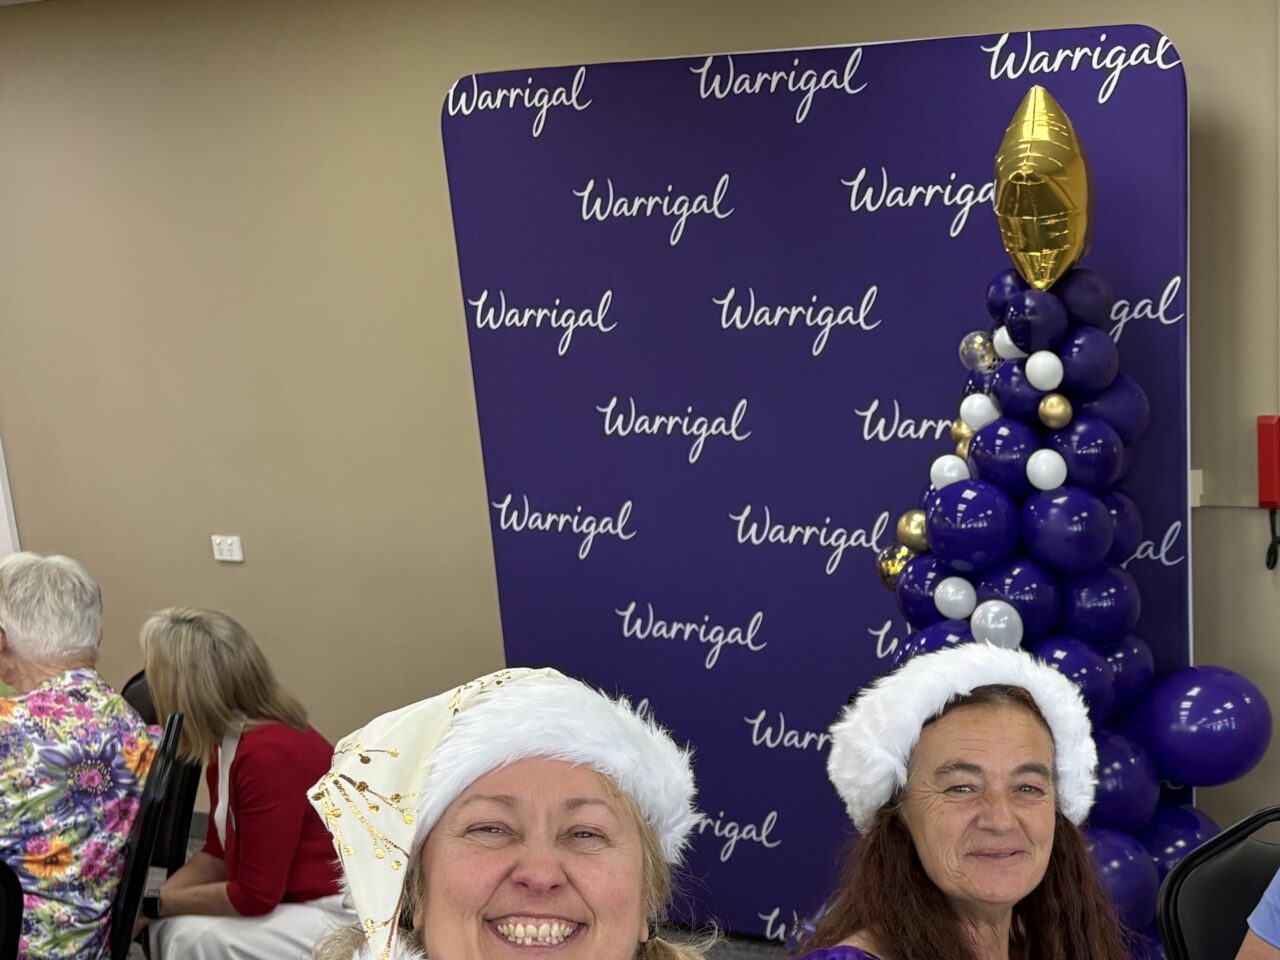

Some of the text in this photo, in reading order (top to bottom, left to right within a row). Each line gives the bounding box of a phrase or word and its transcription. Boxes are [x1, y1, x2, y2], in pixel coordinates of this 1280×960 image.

[448, 66, 592, 138] Warrigal
[689, 47, 868, 124] Warrigal
[980, 31, 1183, 104] Warrigal
[572, 173, 735, 247] Warrigal
[841, 166, 998, 238] Warriga
[468, 289, 618, 356] Warrigal
[712, 285, 882, 357] Warrigal
[596, 396, 752, 464] Warrigal
[855, 399, 953, 442] Warr
[491, 493, 637, 560] Warrigal
[728, 504, 889, 575] Warrigal
[615, 601, 768, 669] Warrigal
[744, 710, 832, 751] Warr
[699, 810, 782, 863] rigal
